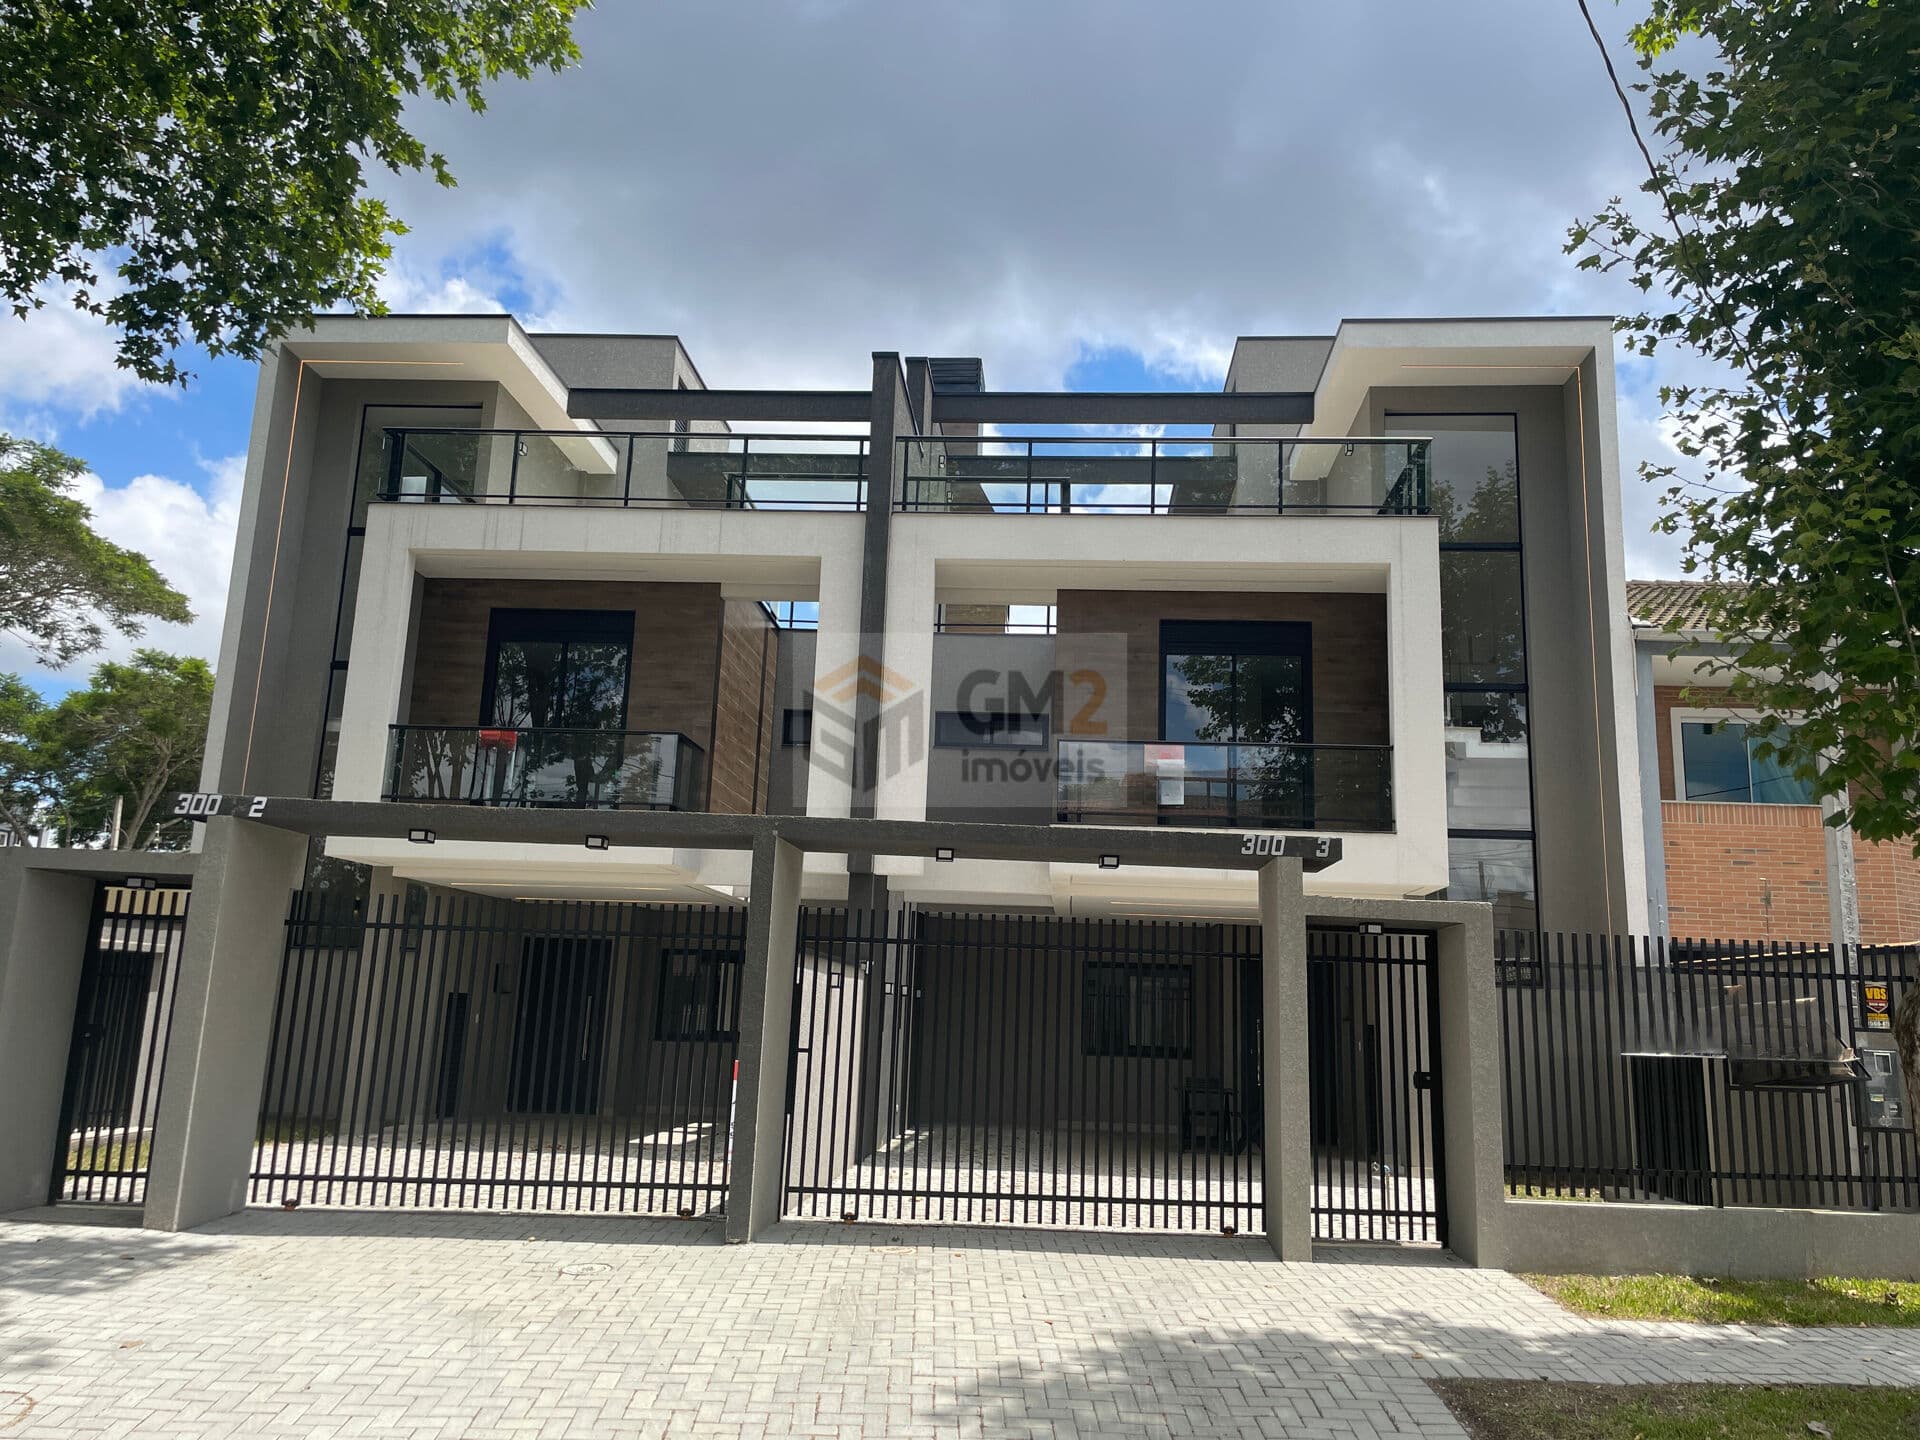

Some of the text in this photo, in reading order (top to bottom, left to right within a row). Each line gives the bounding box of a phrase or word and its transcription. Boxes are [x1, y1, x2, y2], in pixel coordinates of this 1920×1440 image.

[174, 793, 267, 817] 300 2
[1241, 834, 1330, 858] 300 3
[1865, 987, 1886, 1000] VBS
